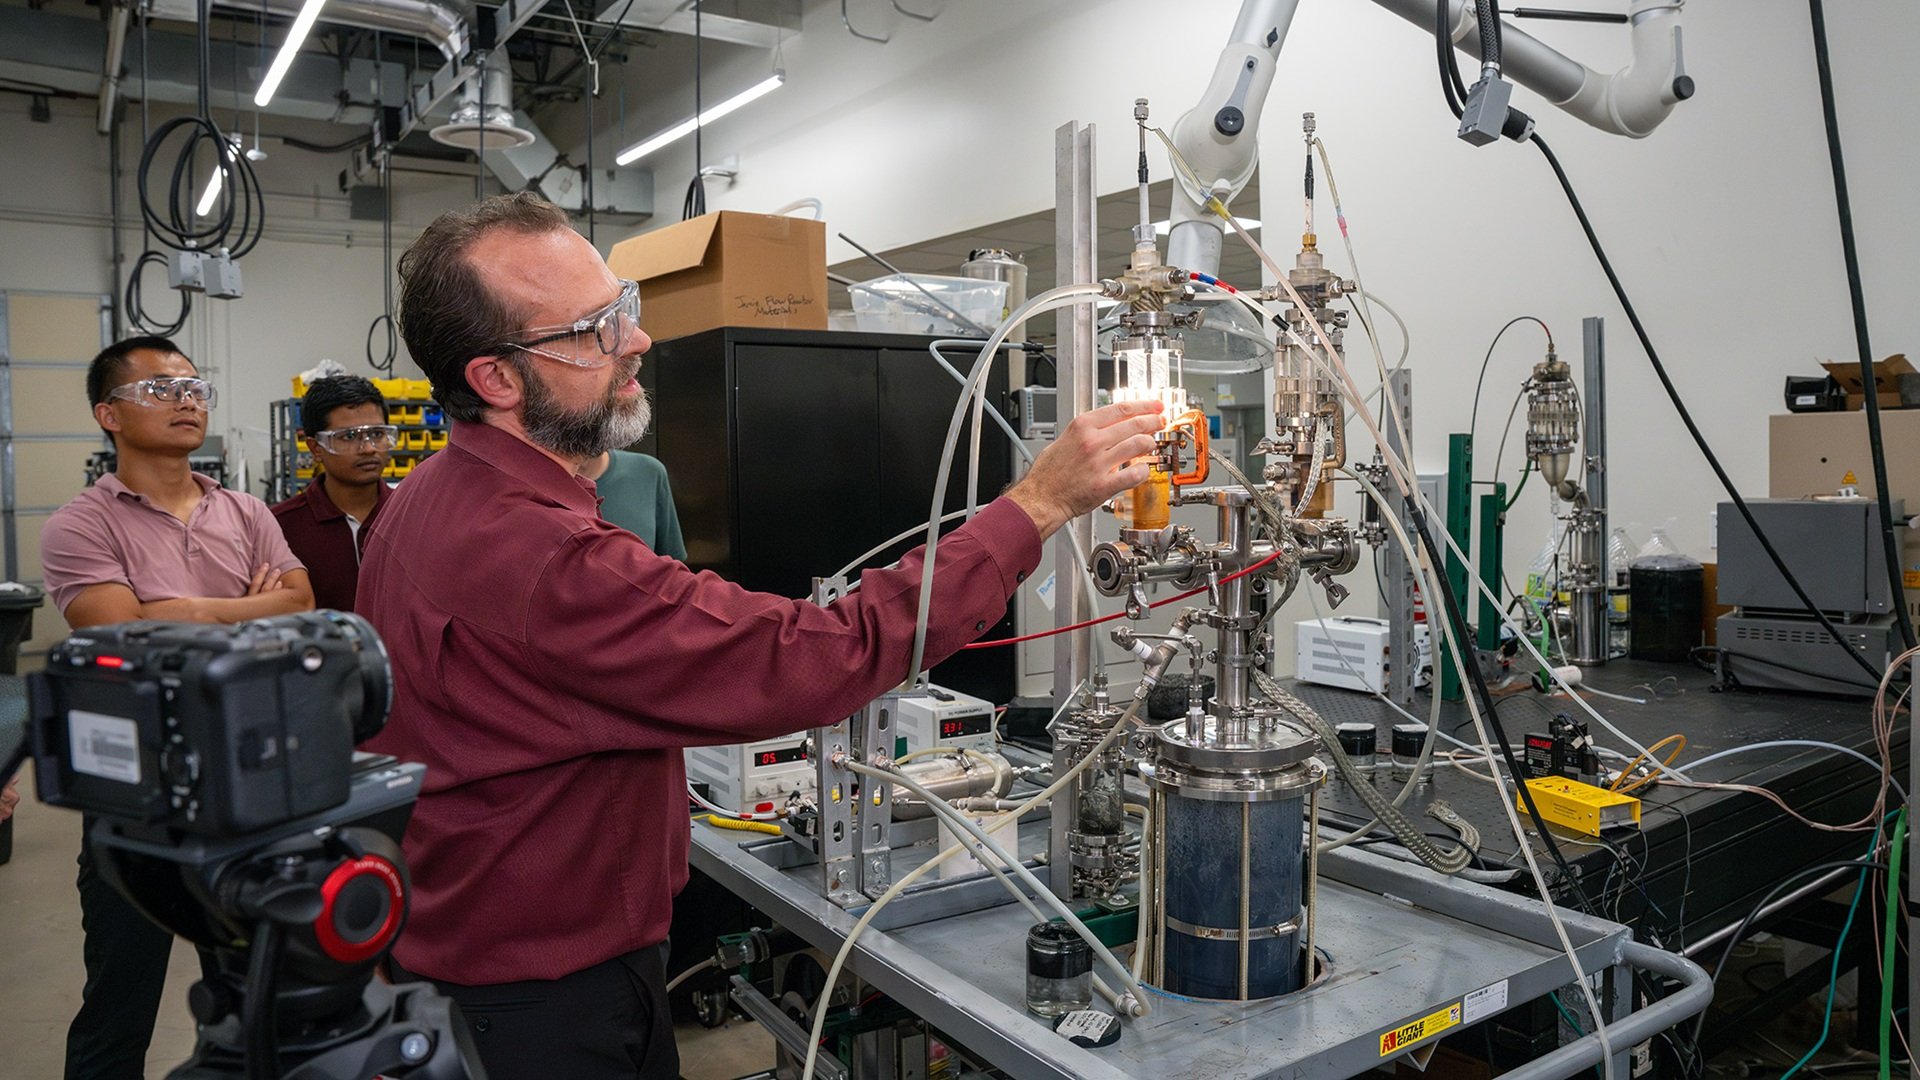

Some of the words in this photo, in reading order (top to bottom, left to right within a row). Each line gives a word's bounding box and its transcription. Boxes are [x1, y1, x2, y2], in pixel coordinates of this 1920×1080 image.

[765, 295, 785, 306] Flow
[1397, 1021, 1425, 1038] LITTLE
[1397, 1029, 1424, 1047] GIANT
